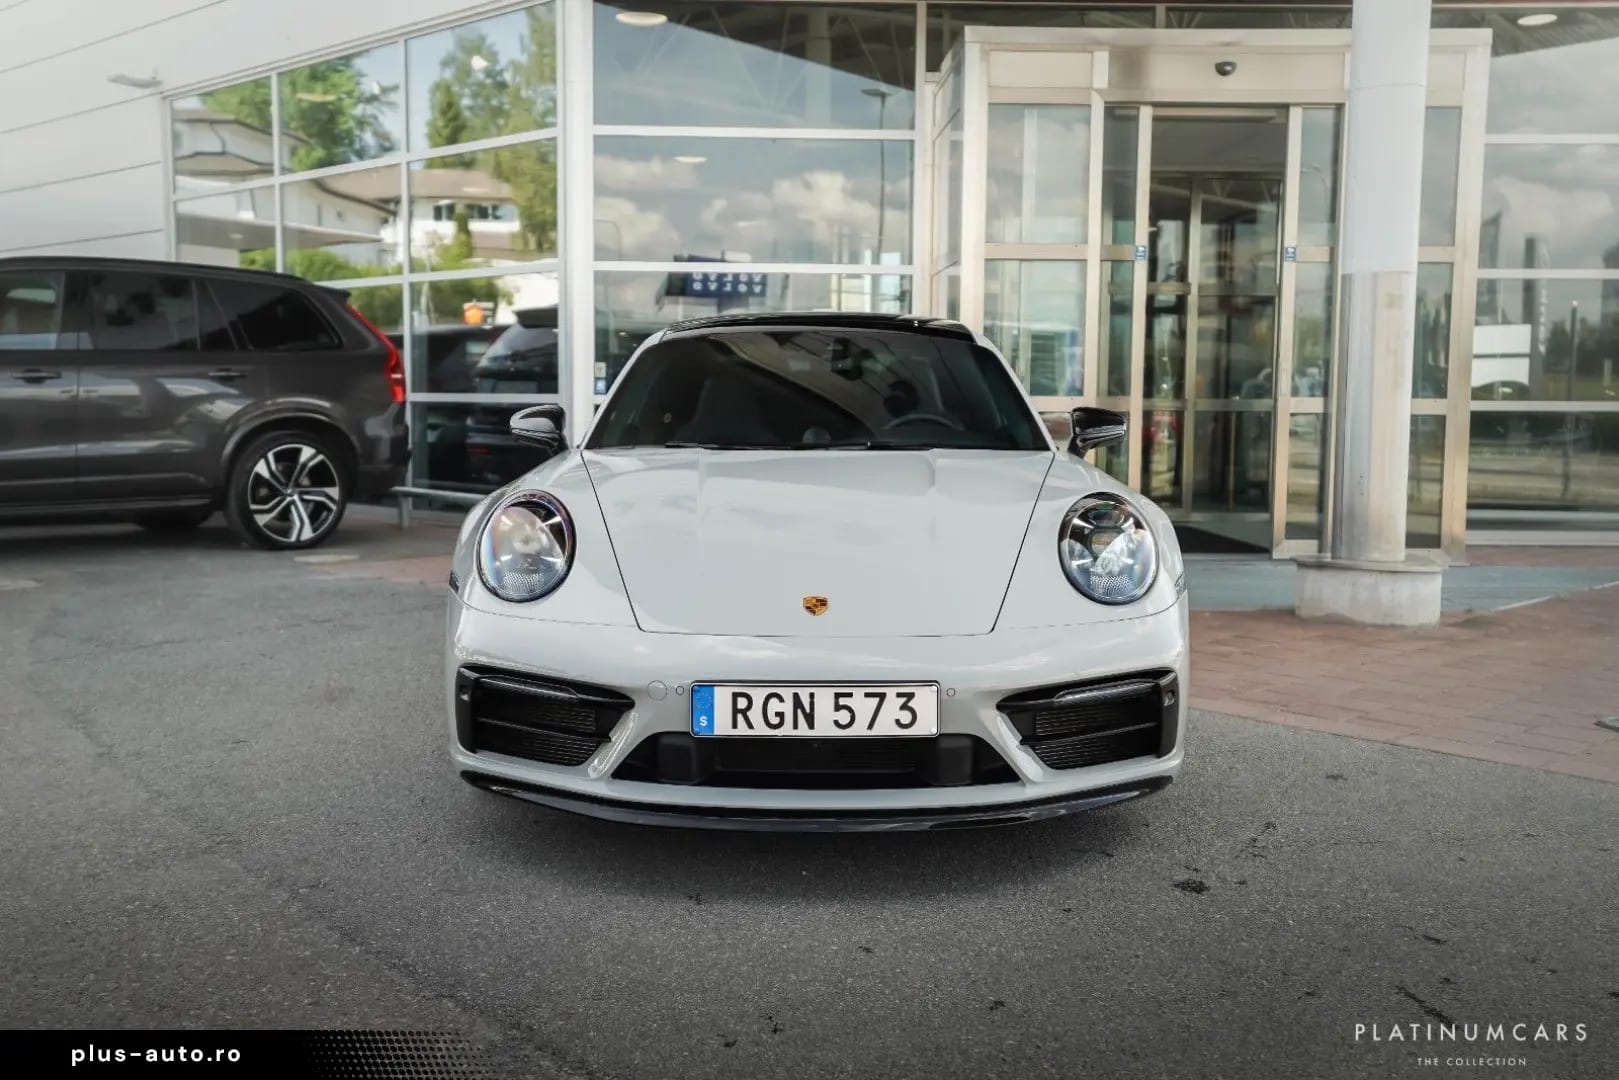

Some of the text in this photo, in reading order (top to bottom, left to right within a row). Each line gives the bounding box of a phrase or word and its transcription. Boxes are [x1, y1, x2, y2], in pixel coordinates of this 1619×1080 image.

[699, 715, 708, 727] S
[731, 691, 918, 730] RGN 573
